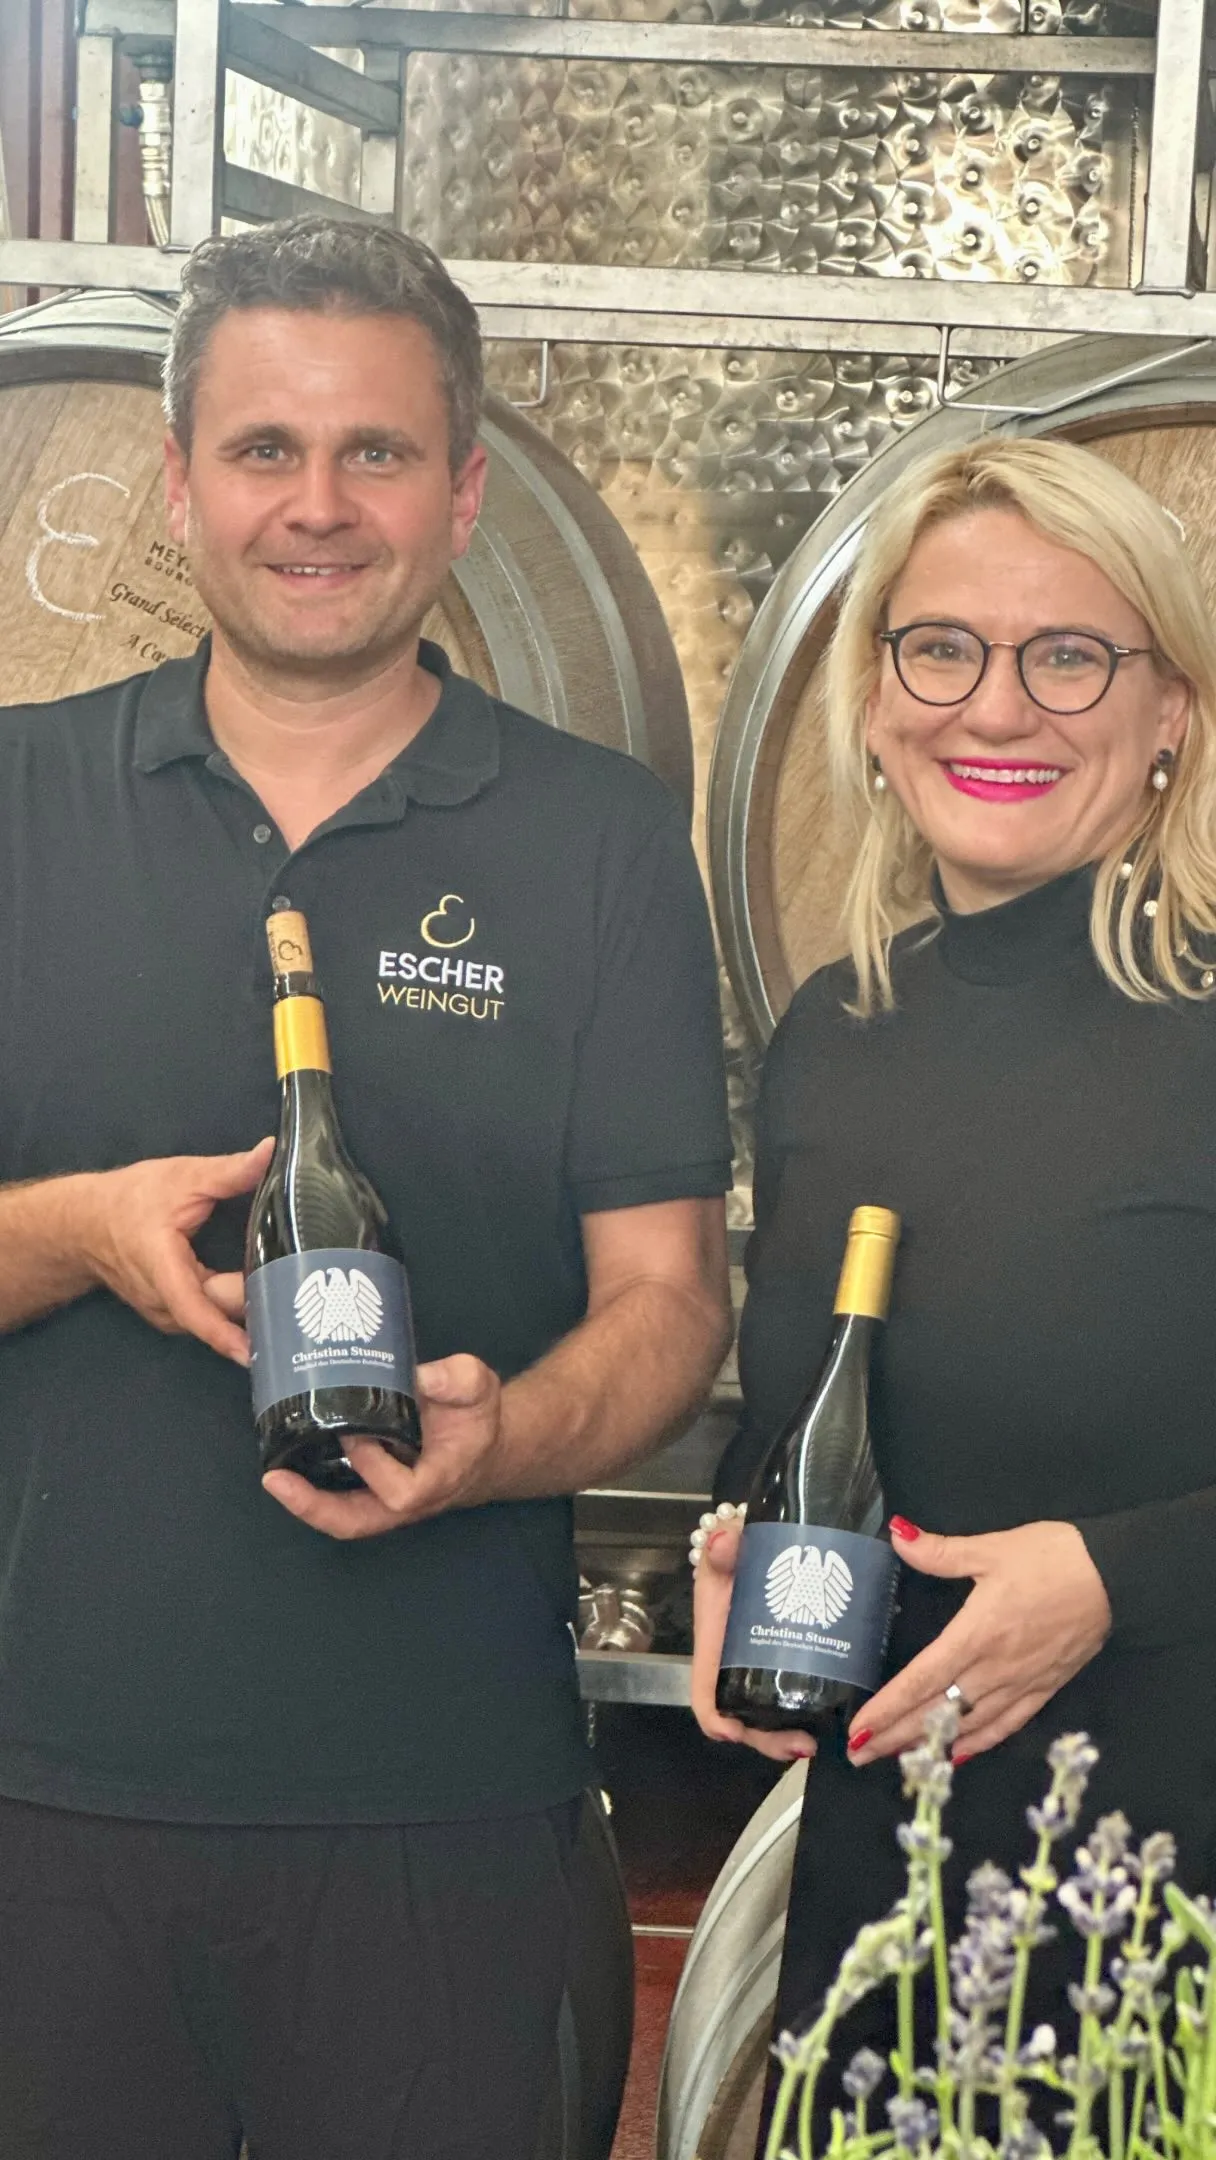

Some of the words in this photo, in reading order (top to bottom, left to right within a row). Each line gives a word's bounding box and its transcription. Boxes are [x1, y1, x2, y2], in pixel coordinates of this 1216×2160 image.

[149, 540, 190, 571] MEY
[109, 582, 167, 616] Grand
[378, 951, 505, 994] ESCHER
[376, 982, 505, 1021] WEINGUT
[292, 1346, 348, 1365] Christina
[349, 1345, 395, 1363] Stumpp
[750, 1624, 803, 1640] Christina
[805, 1631, 852, 1651] Stumpp
